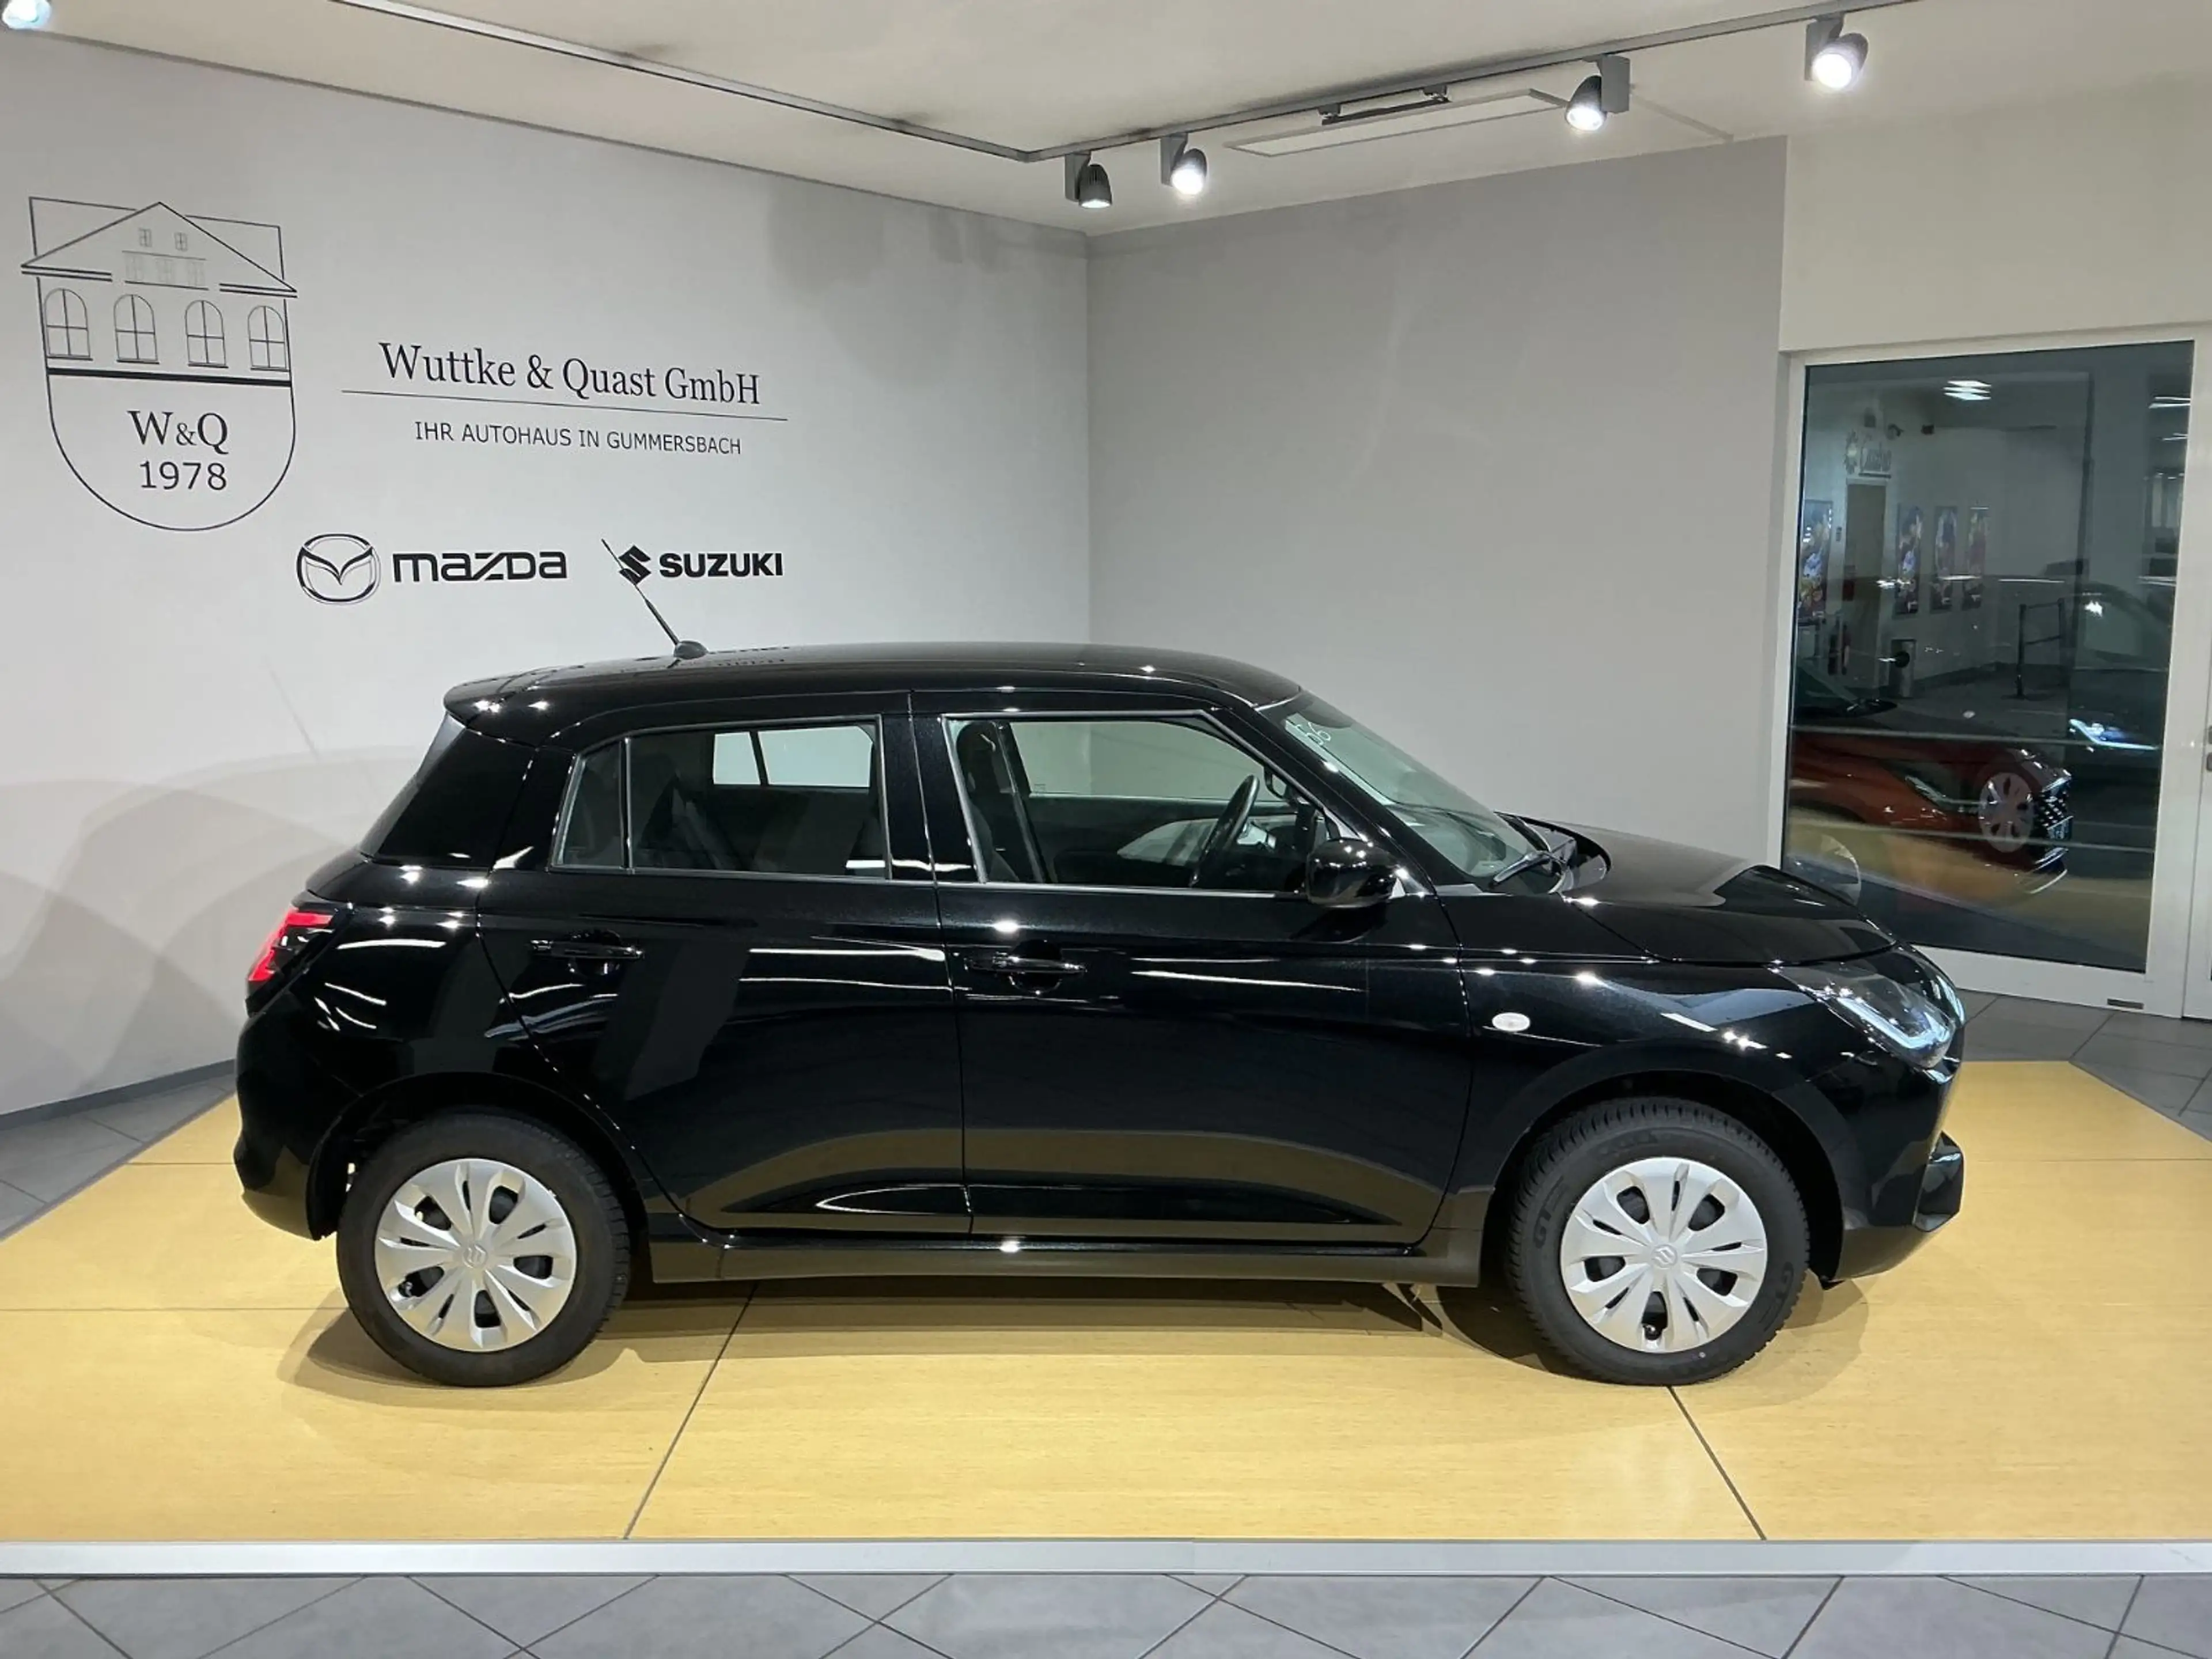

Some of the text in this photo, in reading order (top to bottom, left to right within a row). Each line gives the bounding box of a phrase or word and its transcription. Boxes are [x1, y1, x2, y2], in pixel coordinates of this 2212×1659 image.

[378, 342, 760, 404] Wuttke & Quast GmbH
[126, 410, 230, 455] W&Q
[415, 421, 741, 454] IHR AUTOHAUS IN GUMMERSBACH
[139, 460, 227, 491] 1978
[659, 552, 784, 578] SUZUKI
